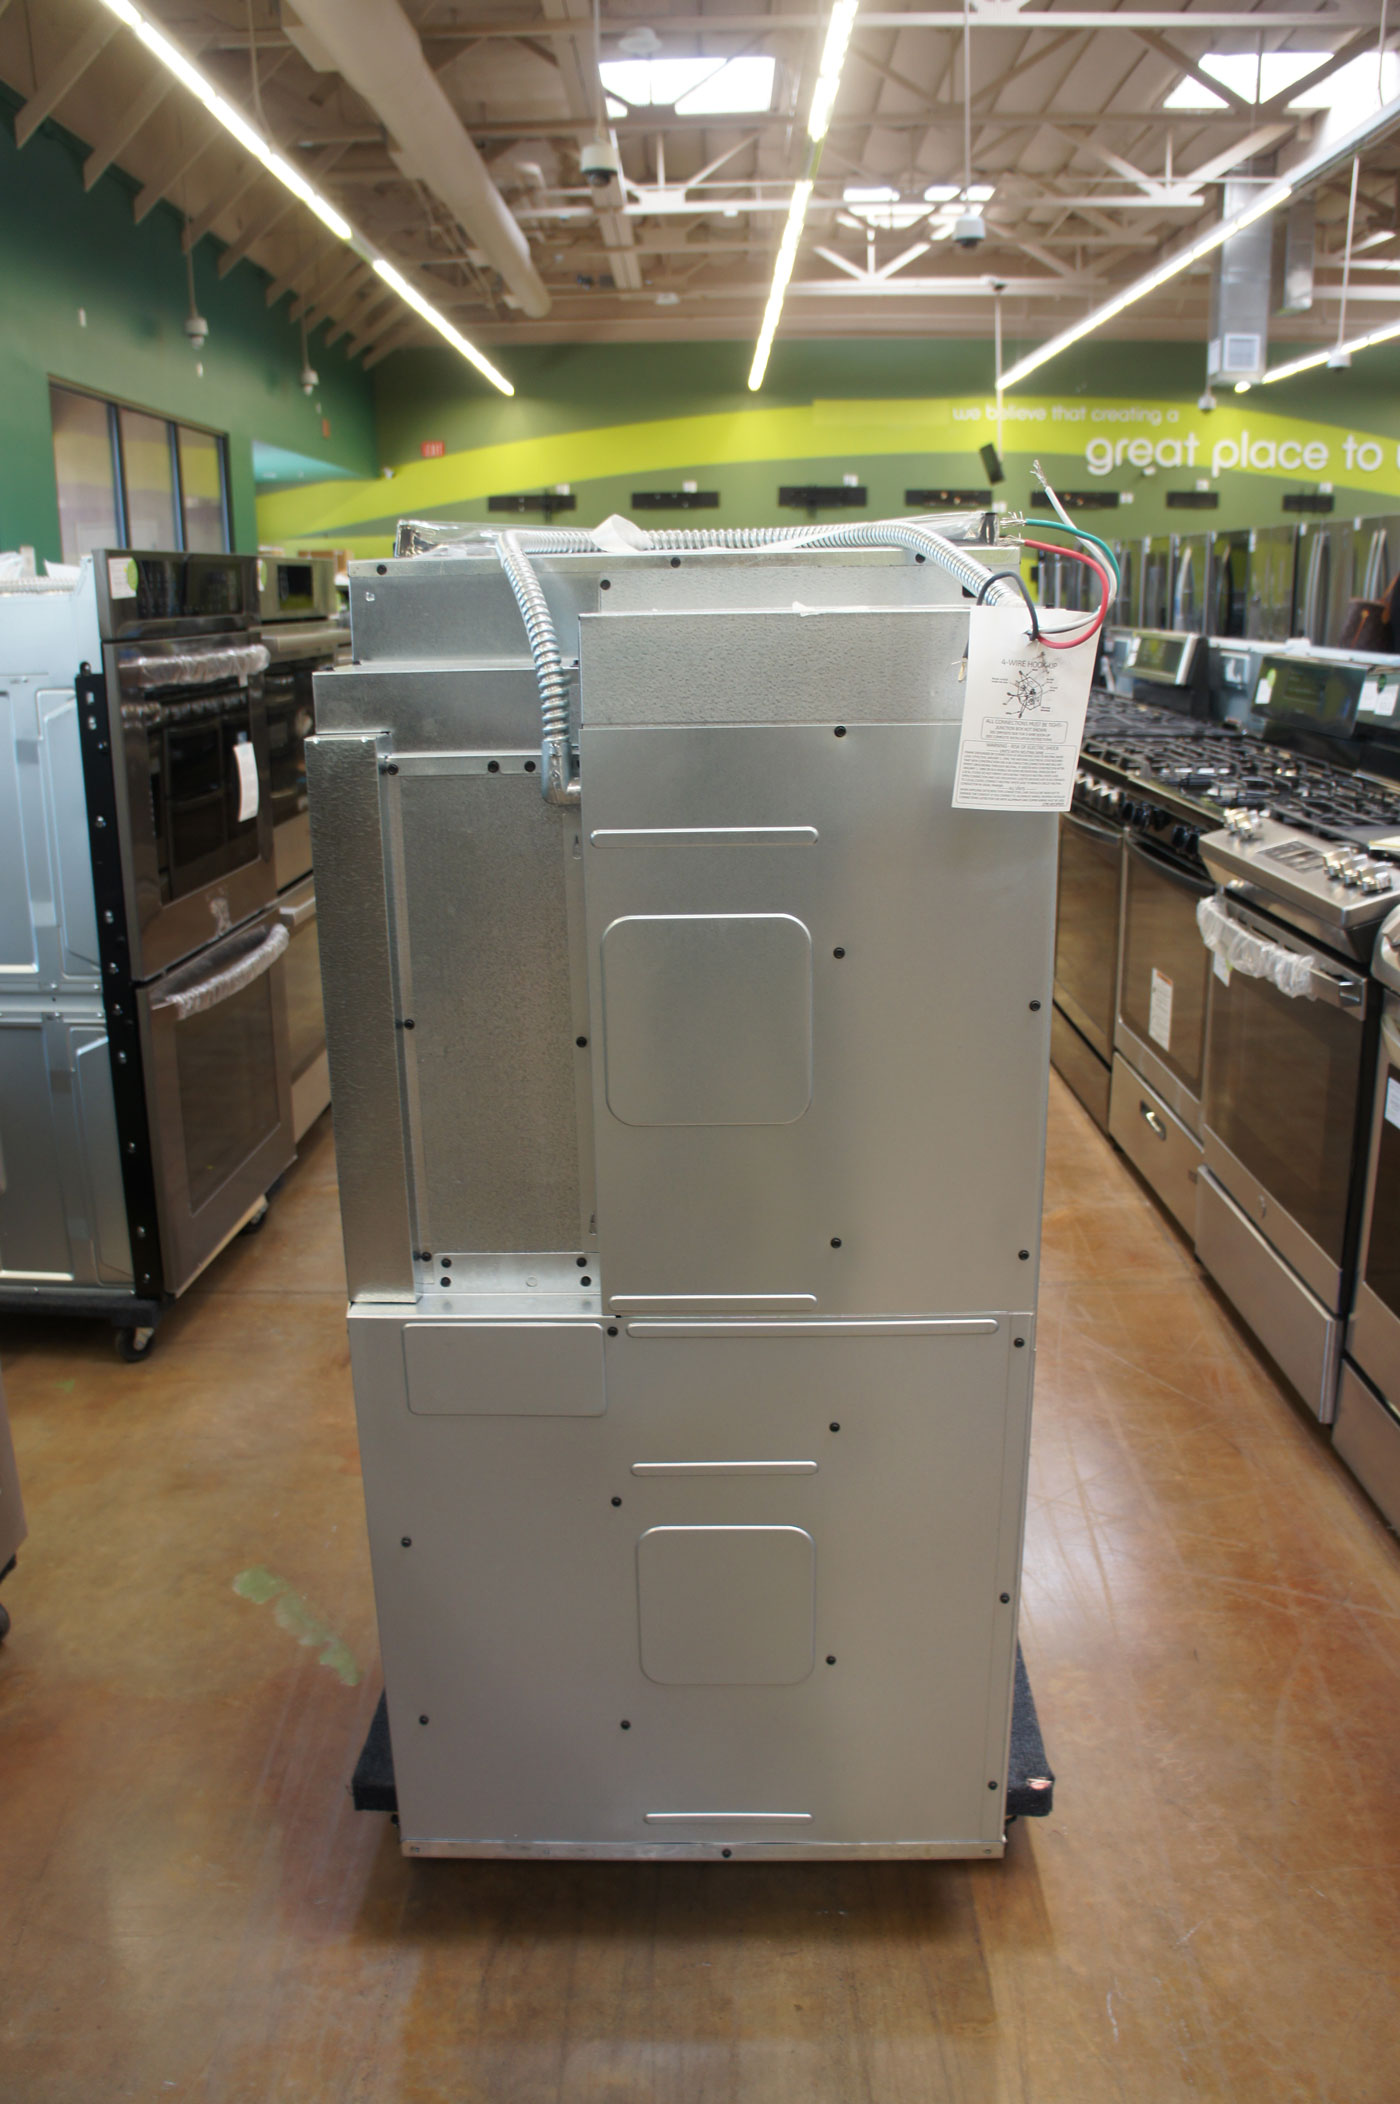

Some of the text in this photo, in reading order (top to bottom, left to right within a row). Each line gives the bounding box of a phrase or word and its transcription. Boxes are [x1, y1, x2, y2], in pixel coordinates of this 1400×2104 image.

[953, 406, 980, 421] we
[1052, 405, 1087, 422] that
[1091, 405, 1163, 426] creating
[1166, 409, 1180, 423] a
[1086, 432, 1200, 476] great
[1212, 431, 1328, 478] place
[1343, 435, 1384, 471] to
[1001, 658, 1026, 668] 4-WIRE
